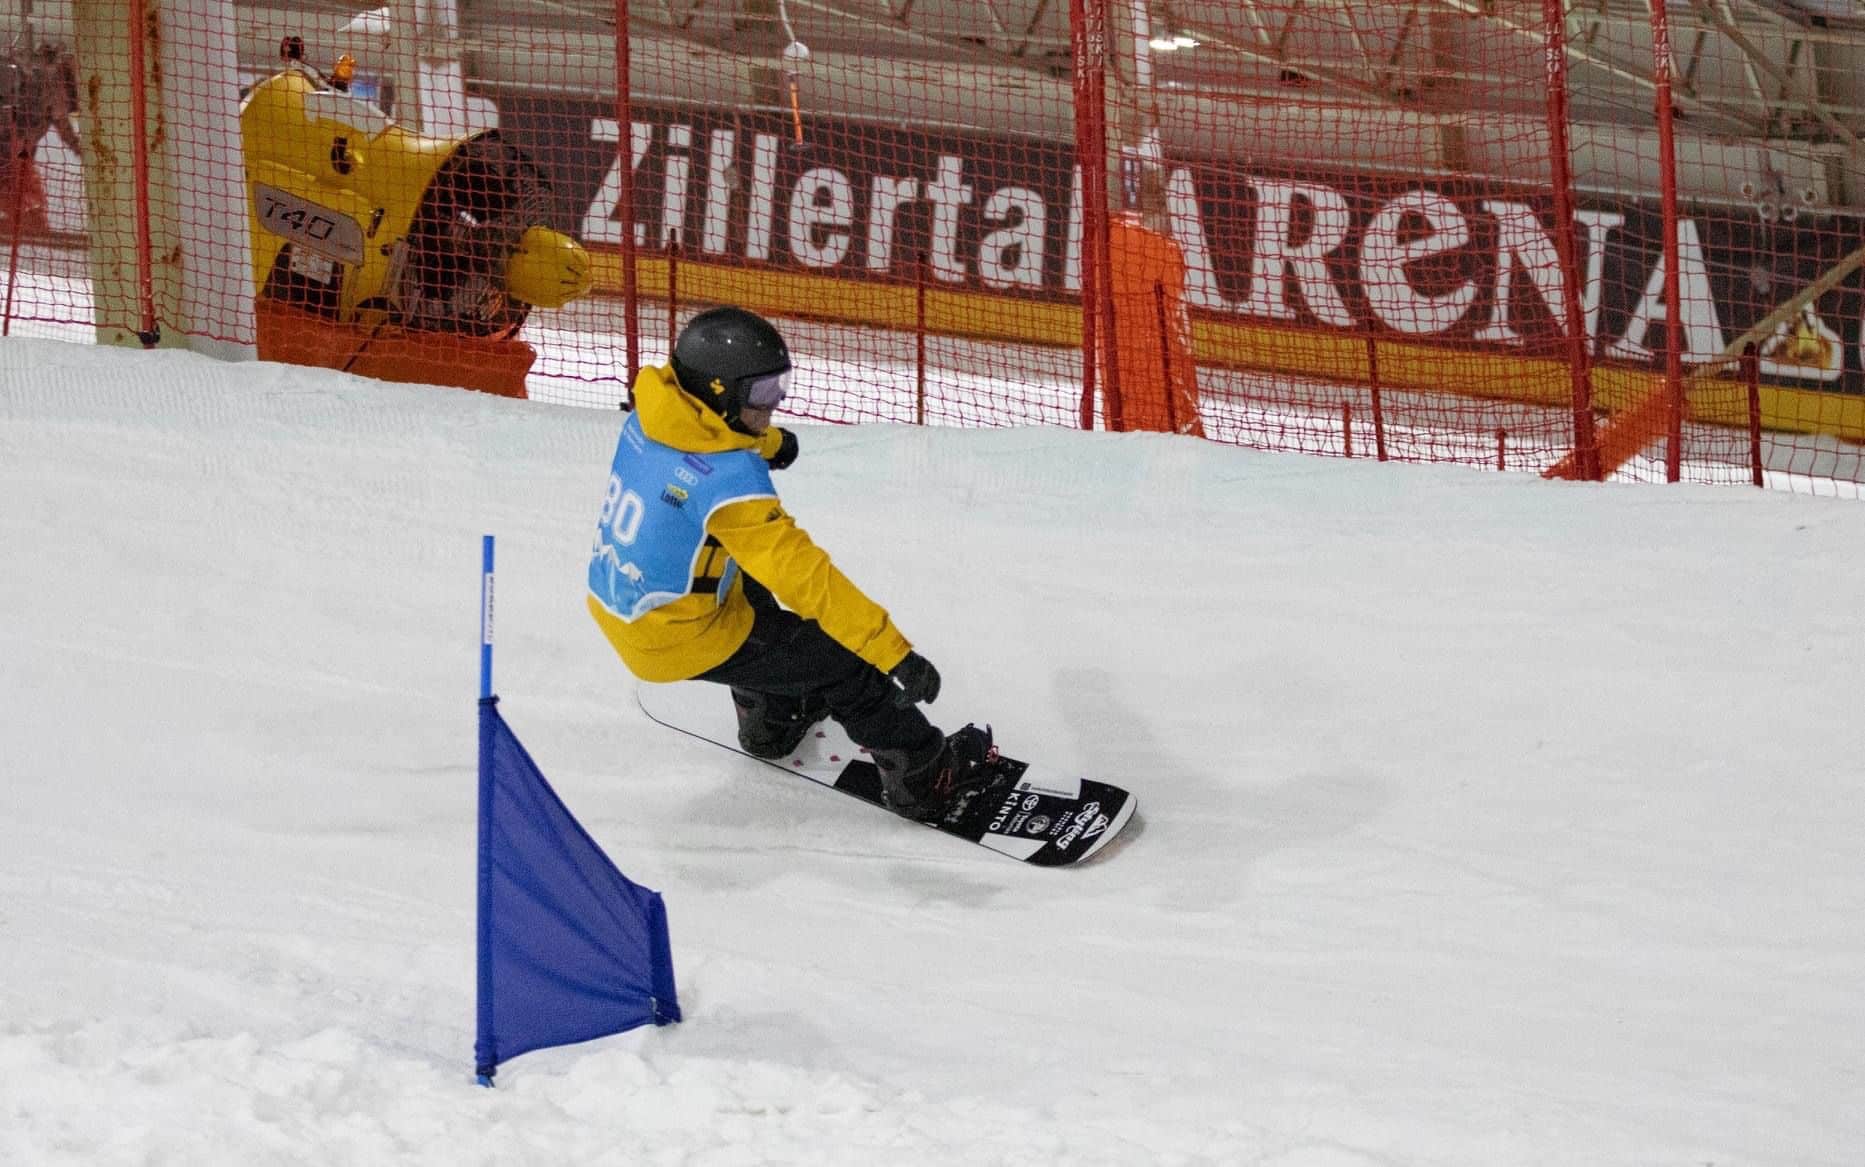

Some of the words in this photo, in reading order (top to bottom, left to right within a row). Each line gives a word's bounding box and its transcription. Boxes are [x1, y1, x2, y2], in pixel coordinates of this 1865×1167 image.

[1077, 32, 1085, 90] LISKI
[265, 197, 336, 240] T40
[581, 119, 1084, 291] Zillertal
[989, 792, 1021, 831] KINTO
